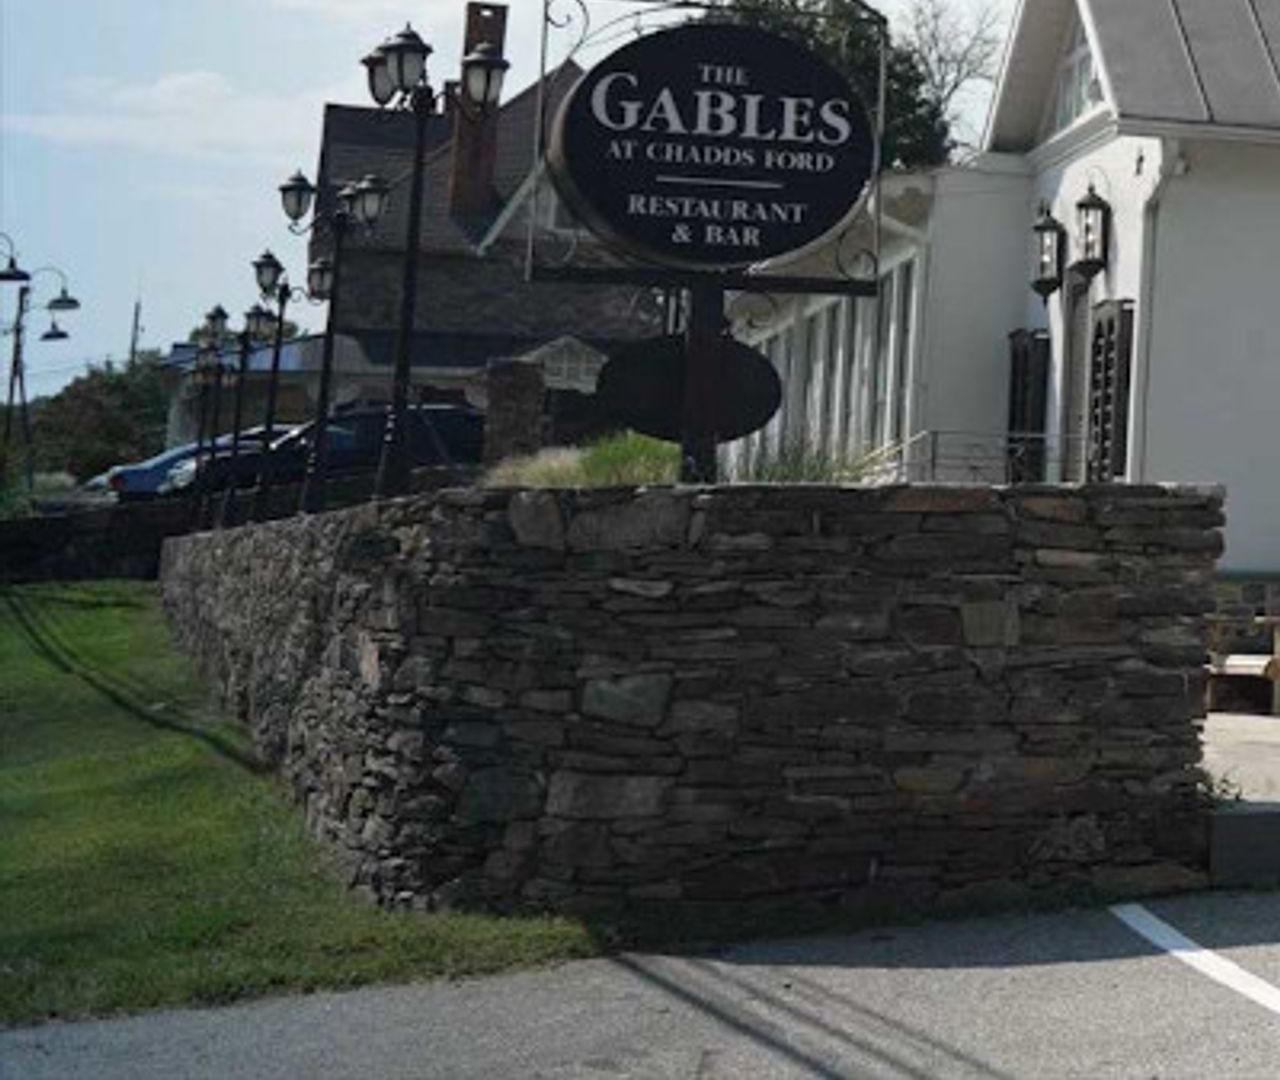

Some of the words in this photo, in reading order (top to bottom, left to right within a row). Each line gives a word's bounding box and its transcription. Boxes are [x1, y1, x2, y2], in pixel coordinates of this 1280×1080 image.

[699, 65, 748, 85] THE
[591, 72, 850, 145] GABLES
[605, 139, 639, 159] AT
[646, 141, 756, 166] CHADDS
[764, 150, 834, 172] FORD
[628, 194, 808, 224] RESTAURANT
[671, 224, 692, 244] &
[705, 225, 761, 247] BAR
